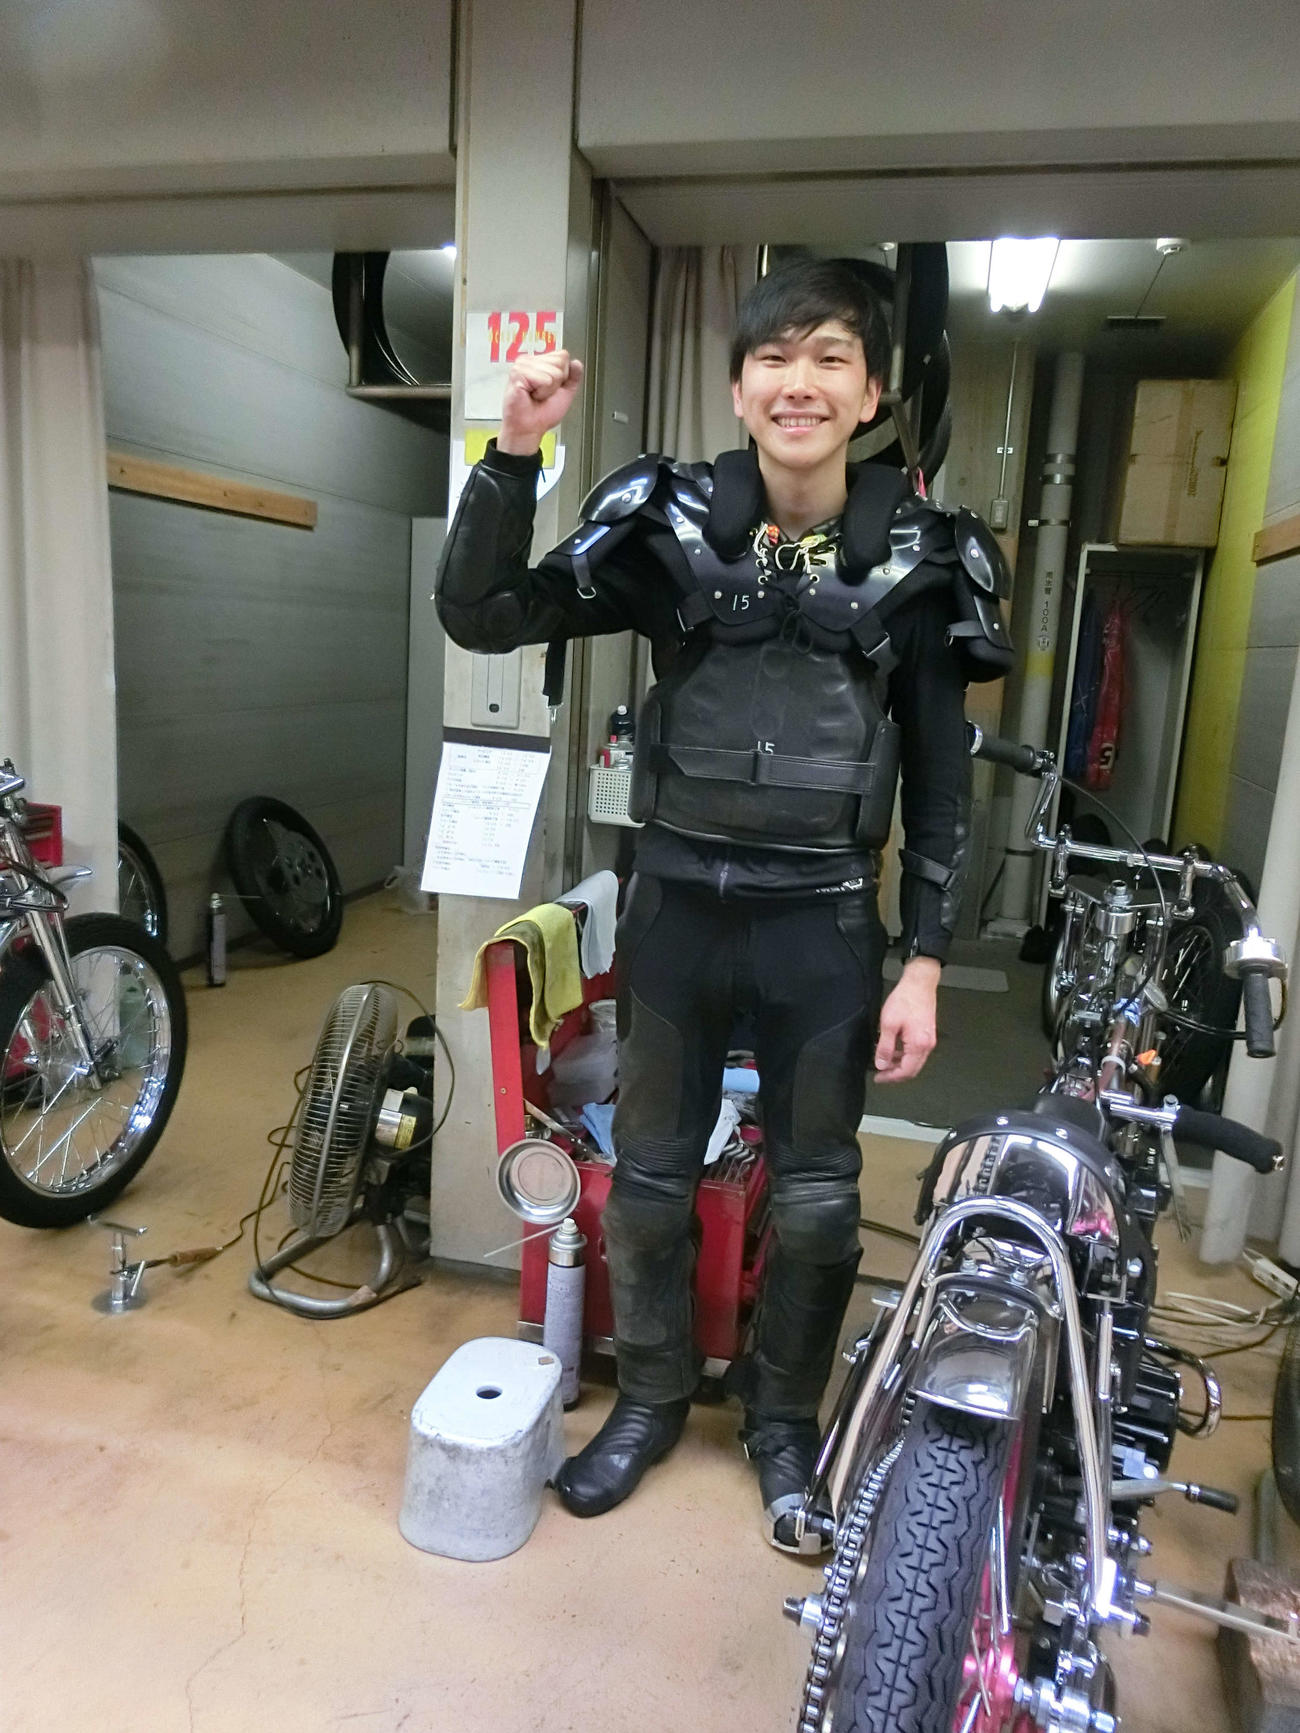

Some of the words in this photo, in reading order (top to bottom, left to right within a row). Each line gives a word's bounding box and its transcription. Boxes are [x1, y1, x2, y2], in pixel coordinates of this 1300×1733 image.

[487, 311, 557, 363] 125
[732, 594, 750, 611] 15
[1040, 600, 1050, 632] 100A
[757, 740, 776, 756] 15
